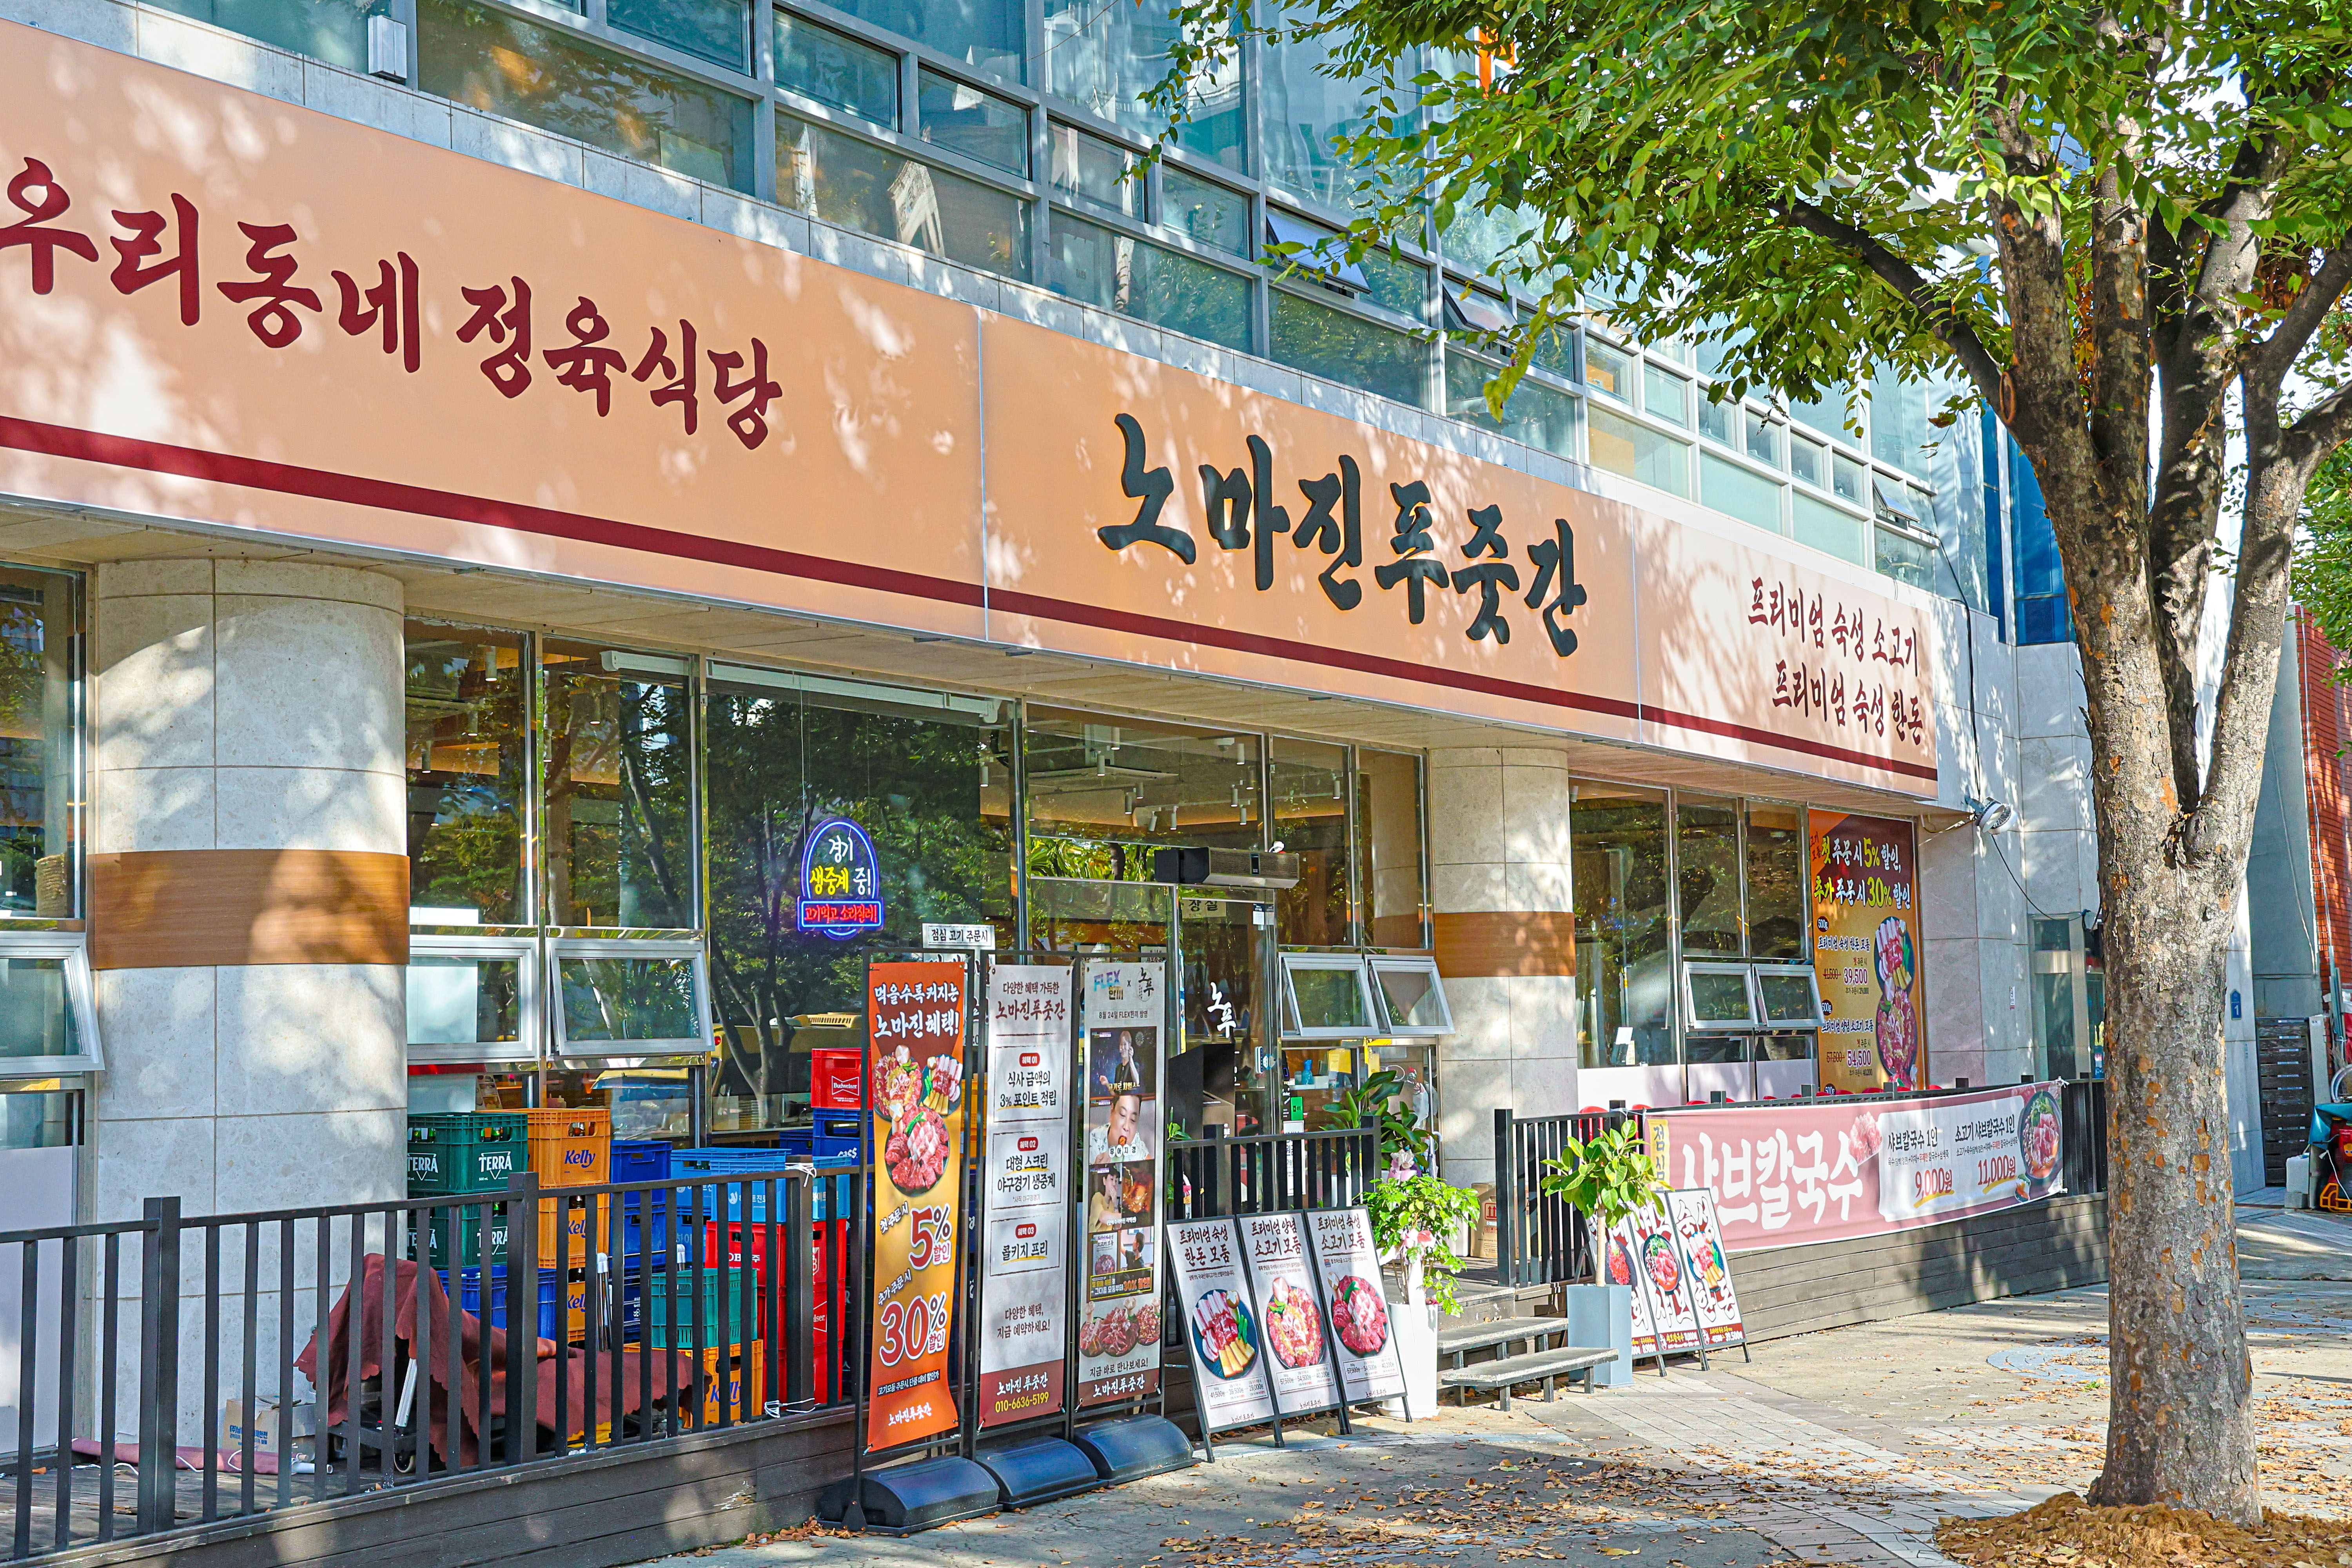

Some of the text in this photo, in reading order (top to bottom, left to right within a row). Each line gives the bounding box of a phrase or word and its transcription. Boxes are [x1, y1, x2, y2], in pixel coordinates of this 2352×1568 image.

[0, 157, 783, 450] 우리동네 정육식당
[1748, 577, 1918, 677] 프리미엄 숙성 소고기
[1773, 659, 1923, 746] 프리미엄 숙성 한돈
[828, 835, 853, 863] 경기
[1821, 836, 1831, 864] 첫
[1863, 837, 1880, 867] 5%
[810, 866, 871, 895] 생중계 중!
[1814, 875, 1835, 904] 추가
[1867, 877, 1892, 907] 30%
[1893, 882, 1910, 910] 할인
[804, 904, 838, 924] 고기먹고
[1182, 900, 1218, 912] 장실
[1818, 919, 1828, 930] 500g
[932, 929, 988, 942] 점심 고기 주문시
[1818, 935, 1838, 951] 프리미엄
[1838, 935, 1848, 951] 숙성
[1094, 969, 1120, 992] FLEX
[1844, 967, 1868, 986] 39,500
[1003, 982, 1059, 994] 다양한 혜택 가득한
[996, 999, 1065, 1020] 노마진푸줏간
[2234, 1005, 2239, 1015] 1
[874, 1009, 959, 1038] 노마진 혜택!
[1851, 1018, 1864, 1033] 소고기
[1847, 1049, 1871, 1069] 54,500
[1007, 1071, 1050, 1087] 식사 금액의
[1000, 1090, 1056, 1107] 3% 포인트 적립
[1955, 1114, 2015, 1143] 소고기 샤브칼국수 1인
[1888, 1127, 1938, 1152] 샤브칼국수 1인
[479, 1155, 512, 1172] TERRA
[564, 1150, 596, 1168] Kelly
[1006, 1153, 1048, 1171] 대형 스크린
[1682, 1128, 1863, 1230] 샤브칼국수
[1978, 1155, 2016, 1187] 11,000원
[998, 1173, 1055, 1192] 야구경기 생중계
[1915, 1167, 1952, 1200] 9,000원
[1251, 1217, 1297, 1236] 프리미엄 양념
[1318, 1214, 1360, 1230] 프리미엄 숙성
[1676, 1196, 1715, 1240] 숙성
[909, 1203, 952, 1270] 5%
[1180, 1224, 1228, 1244] 프리미엄 숙성
[1322, 1232, 1365, 1250] 소고기 모둠
[933, 1241, 951, 1265] 할인
[1002, 1240, 1047, 1261] 콜키지 프리
[1185, 1244, 1230, 1267] 한돈 모둠
[1255, 1236, 1301, 1257] 소고기 모둠
[1695, 1278, 1735, 1322] 한돈
[1005, 1303, 1044, 1320] 다양한 혜택,
[880, 1291, 947, 1366] 30%
[997, 1319, 1050, 1339] 지금 예약하세요!
[928, 1328, 945, 1353] 할인
[927, 1370, 939, 1382] 할인가
[1090, 1357, 1148, 1377] 지금 바로 만나보세요!
[1093, 1374, 1145, 1397] 노마진푸줏간
[995, 1392, 1049, 1413] 010-6636-5199
[888, 1402, 932, 1426] 노마진푸줏간
